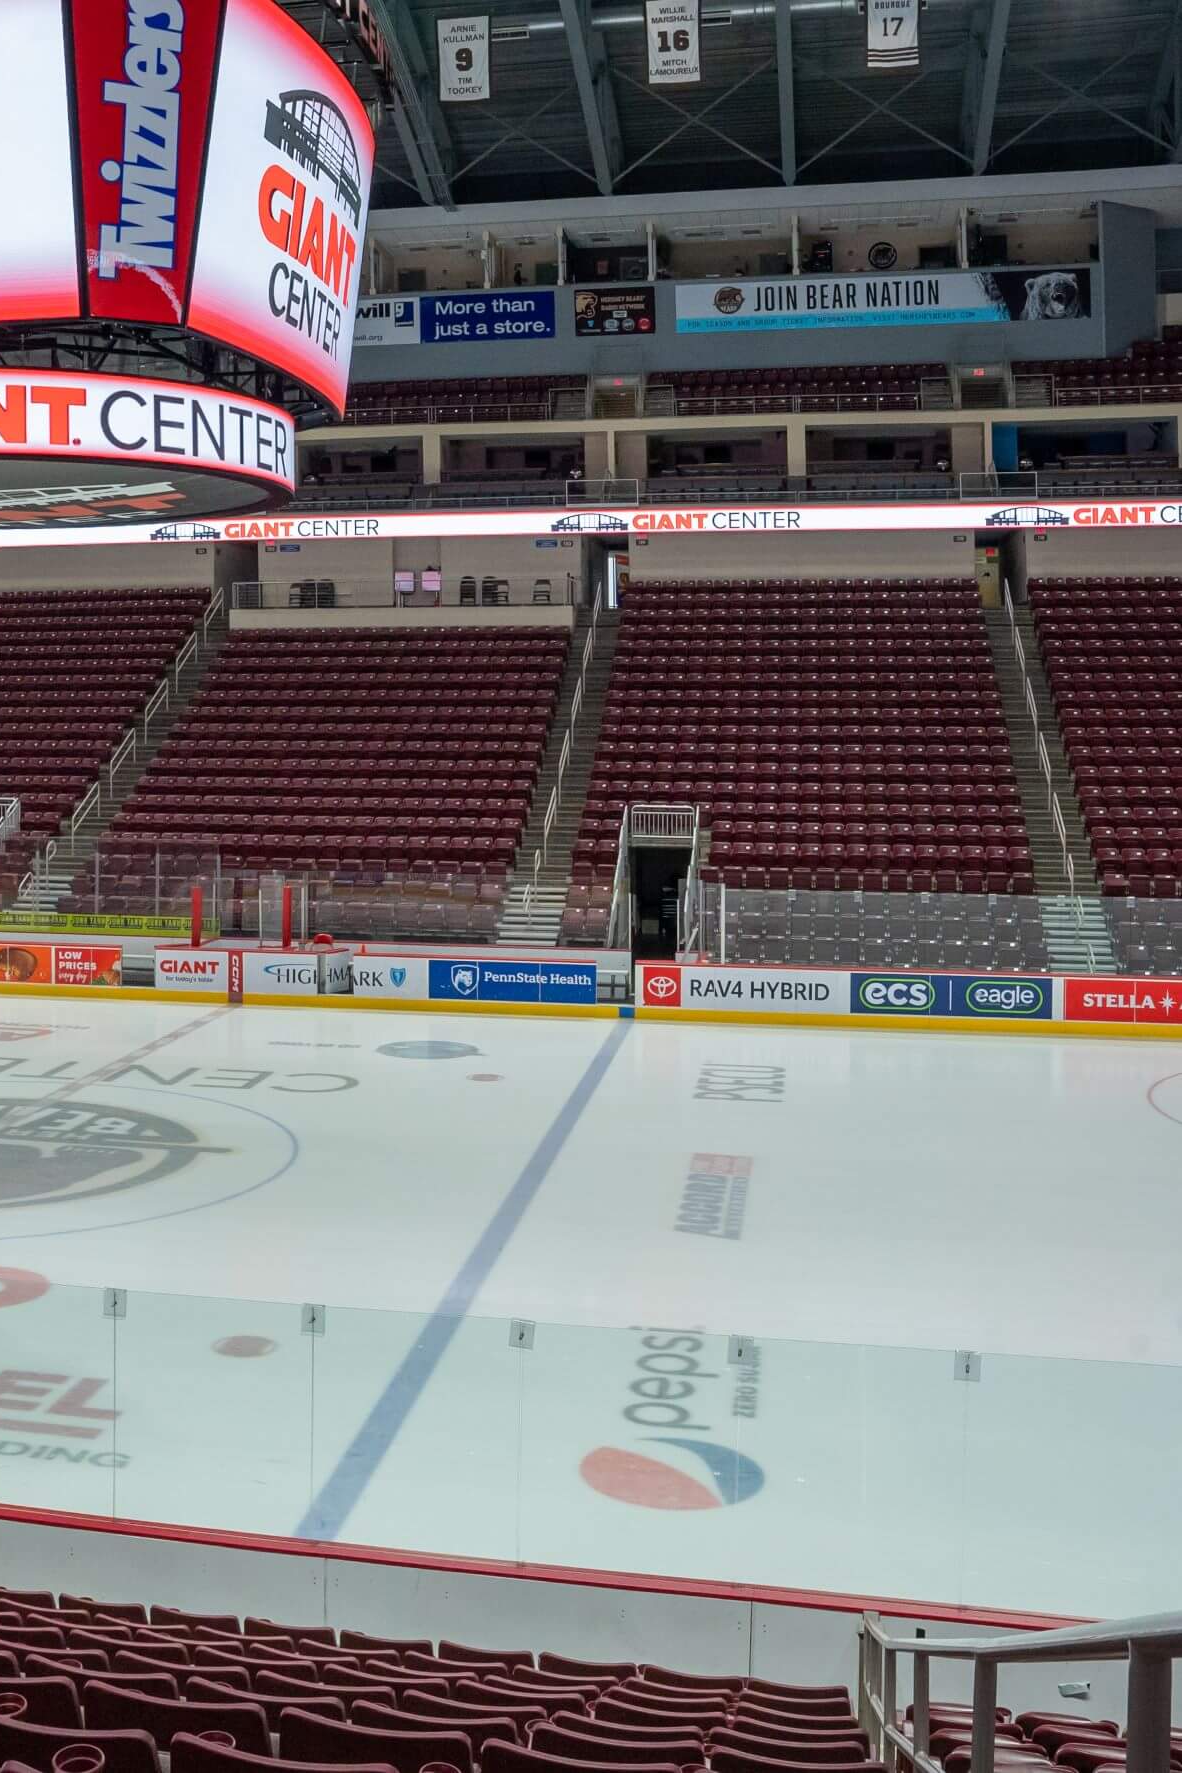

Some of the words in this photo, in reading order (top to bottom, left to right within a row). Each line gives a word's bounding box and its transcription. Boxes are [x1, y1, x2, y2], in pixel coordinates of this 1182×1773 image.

[659, 6, 686, 14] WILLIE
[450, 24, 477, 33] ARNIE
[651, 15, 695, 25] MARSHALL
[882, 17, 904, 37] 17
[443, 34, 485, 43] KULLMAN
[657, 30, 690, 53] 16
[455, 48, 473, 72] 9
[662, 58, 687, 67] MITCH
[457, 77, 473, 85] TIM
[649, 66, 699, 77] LAMOUREUX
[447, 86, 483, 95] TOOKEY
[98, 0, 185, 280] Twizzlers
[258, 164, 356, 308] GIANT
[754, 286, 797, 311] JOIN
[806, 284, 857, 309] BEAR
[866, 280, 939, 307] NATION
[268, 262, 341, 361] CENTER
[434, 301, 486, 316] More
[492, 298, 535, 313] than
[434, 321, 469, 340] just
[476, 323, 487, 335] a
[492, 319, 551, 334] store.
[100, 390, 288, 477] CENTER
[632, 513, 707, 530] GIANT
[711, 511, 801, 529] CENTER
[1073, 506, 1156, 524] GIANT
[224, 521, 293, 538] GIANT
[297, 519, 379, 537] CENTER
[59, 951, 81, 960] LOW
[59, 961, 97, 970] PRICES
[160, 959, 219, 975] GIANT
[484, 971, 547, 984] PennState
[550, 974, 591, 985] Health
[690, 979, 744, 998] RAV4
[750, 981, 830, 1001] HYBRID
[865, 982, 928, 1006] ecs
[975, 986, 1035, 1008] eagle
[1083, 992, 1155, 1009] STELLA
[622, 1325, 722, 1431] pepsi
[732, 1386, 758, 1419] ZERO
